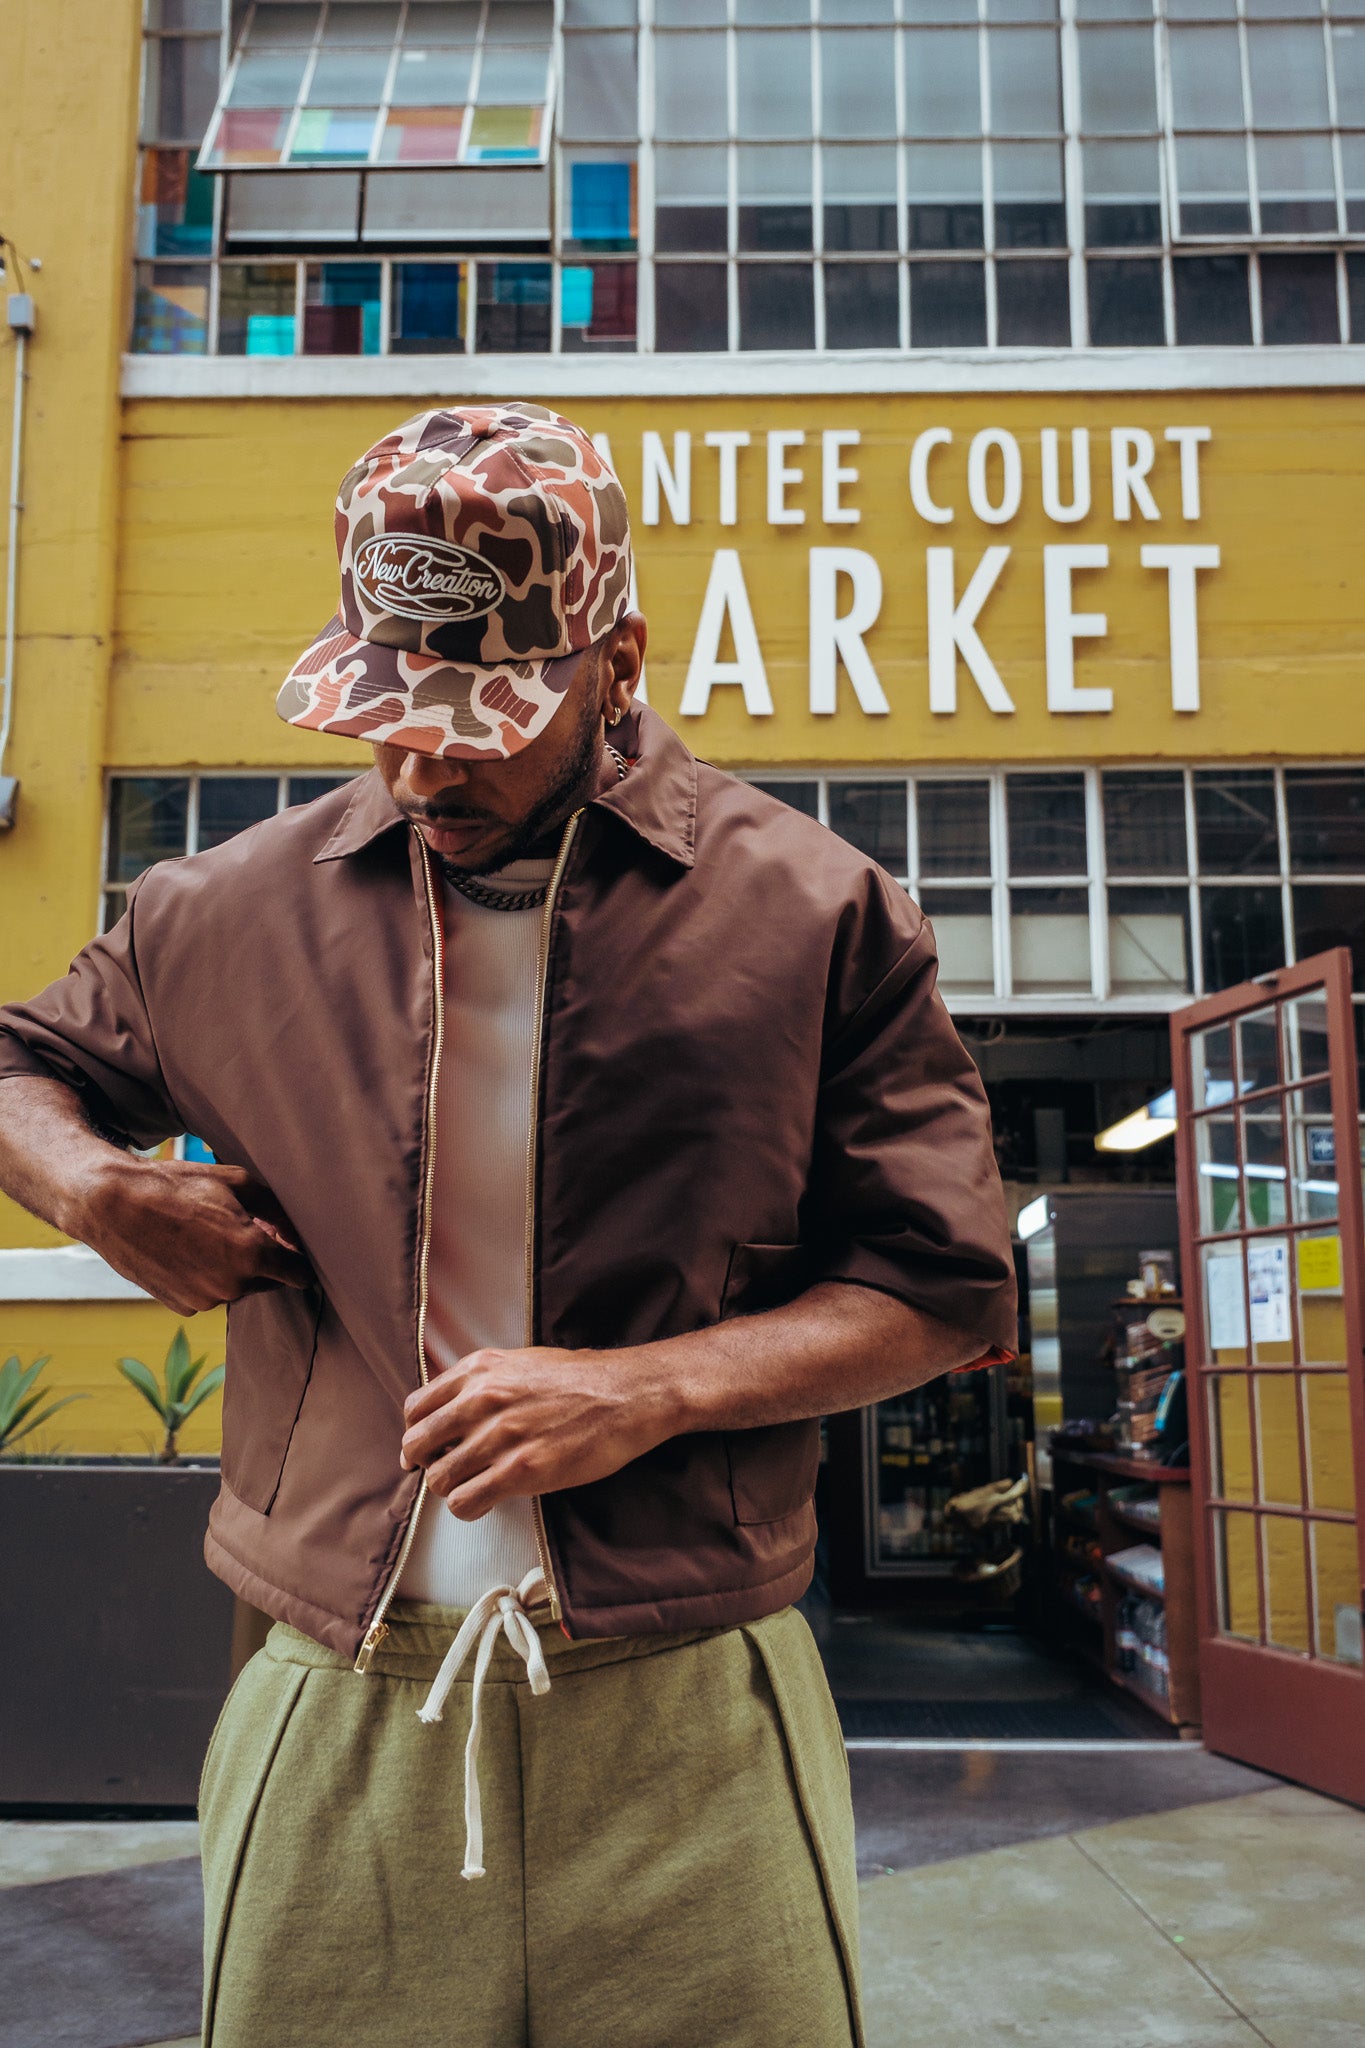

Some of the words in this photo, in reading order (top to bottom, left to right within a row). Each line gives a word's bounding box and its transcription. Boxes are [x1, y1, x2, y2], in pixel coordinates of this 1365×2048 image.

[909, 425, 1213, 525] COURT
[358, 542, 403, 582] New
[401, 546, 499, 600] Creation
[629, 544, 1221, 716] ARKET
